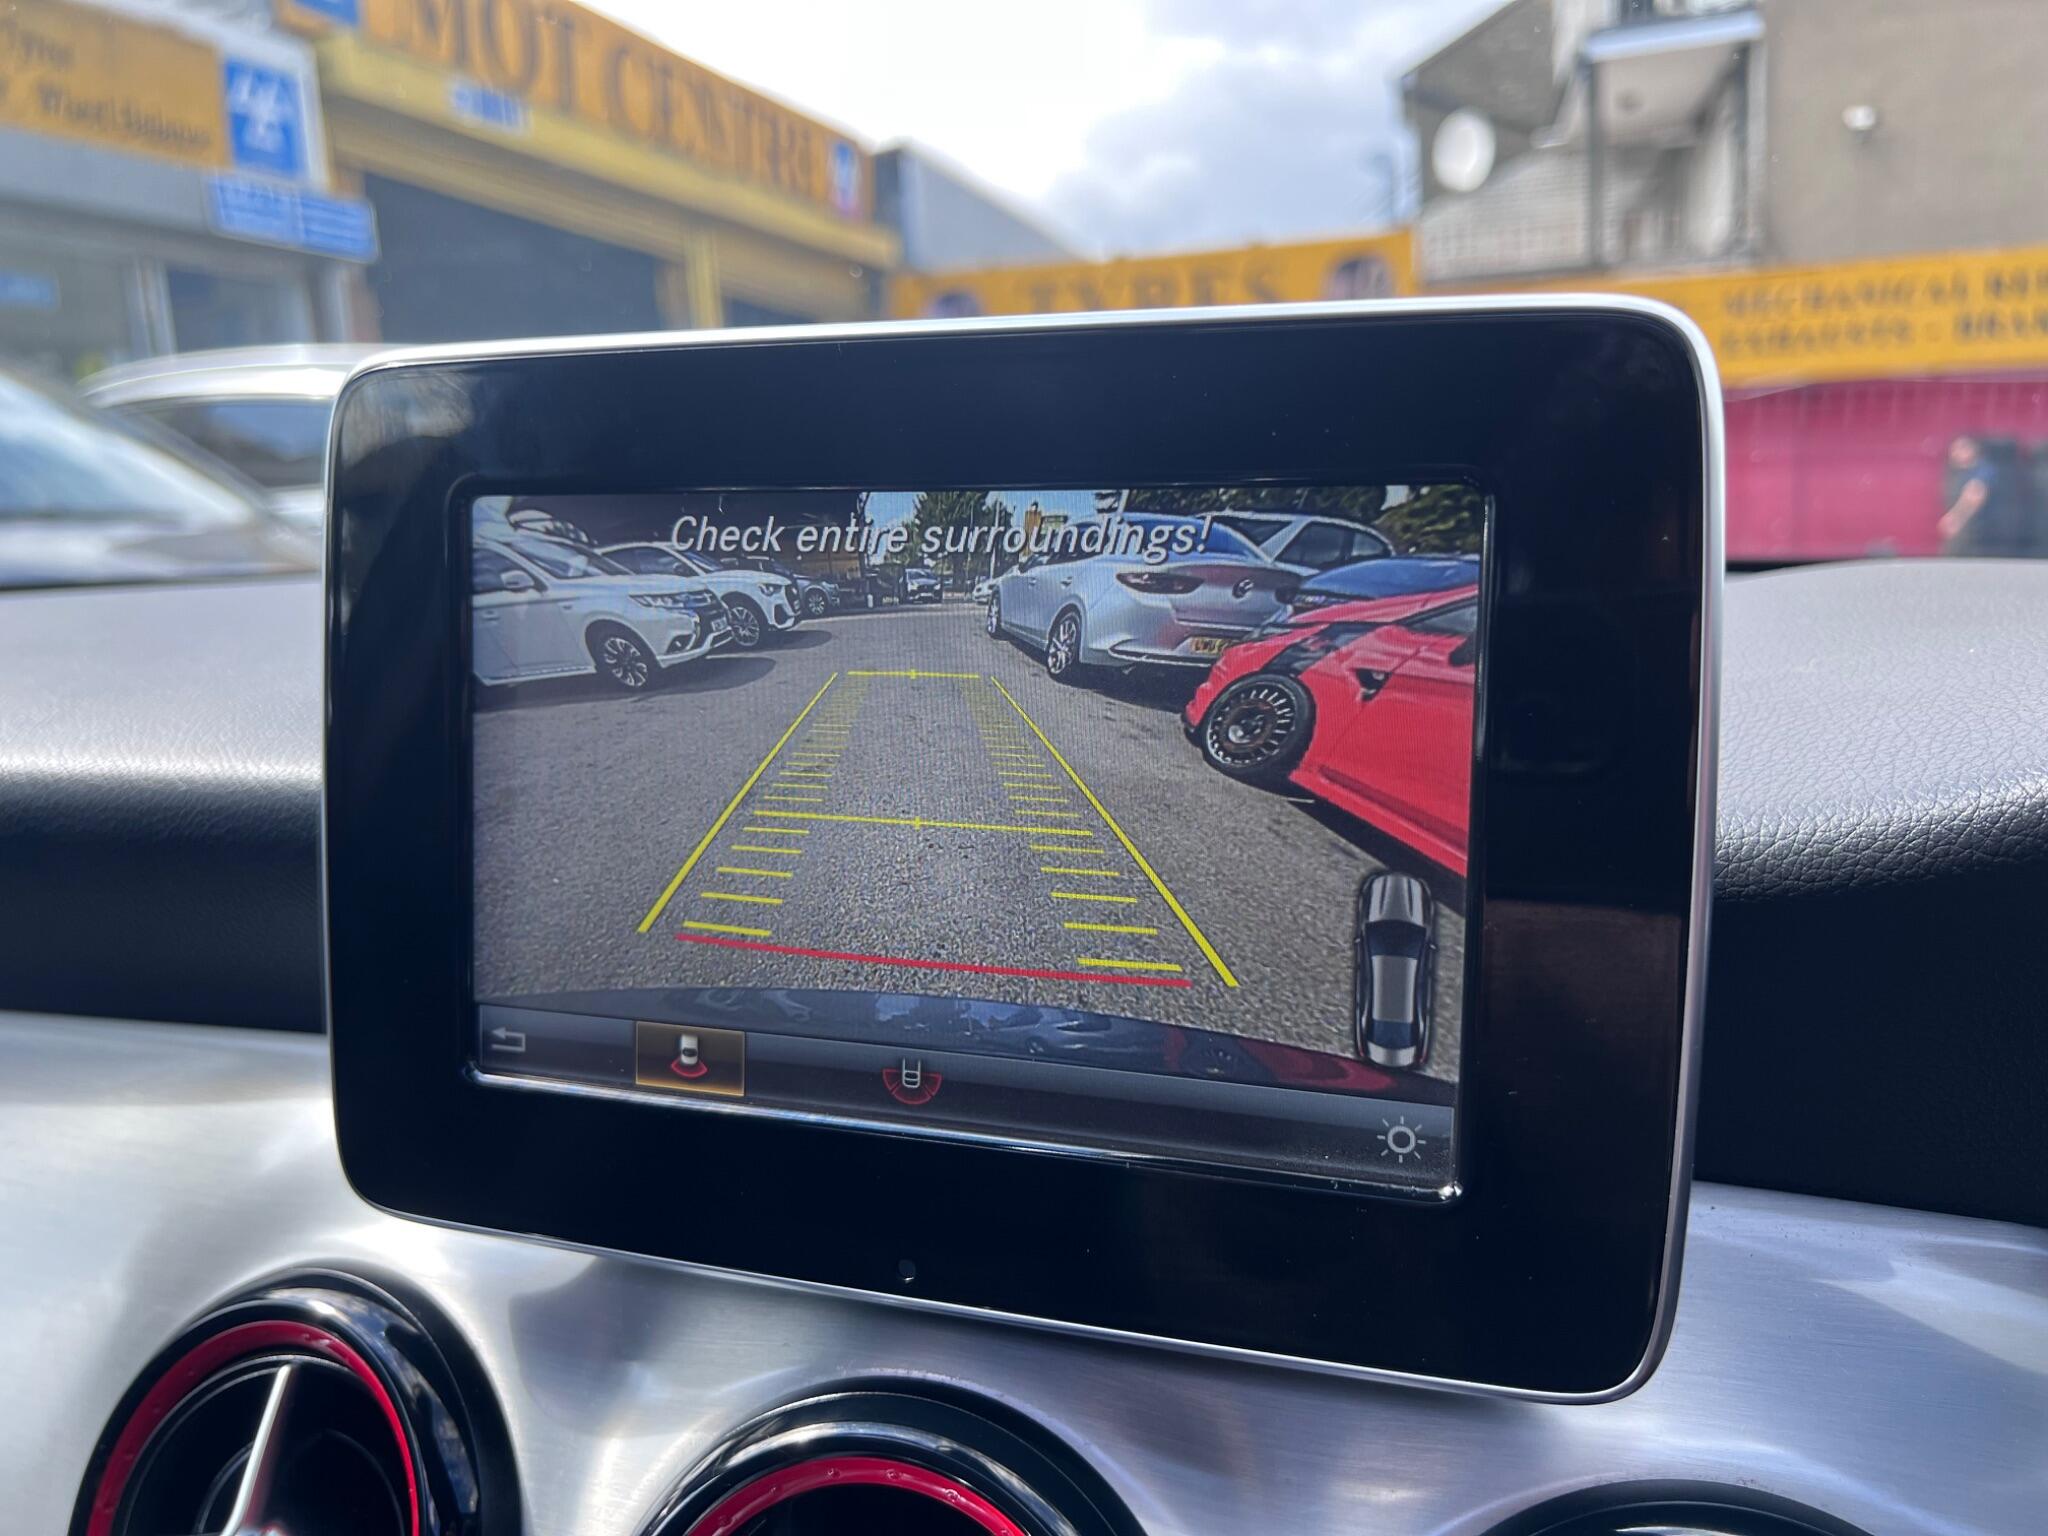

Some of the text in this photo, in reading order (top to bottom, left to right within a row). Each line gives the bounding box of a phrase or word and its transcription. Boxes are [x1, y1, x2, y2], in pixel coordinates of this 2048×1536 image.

[671, 514, 1212, 565] Check entire surroundings!
